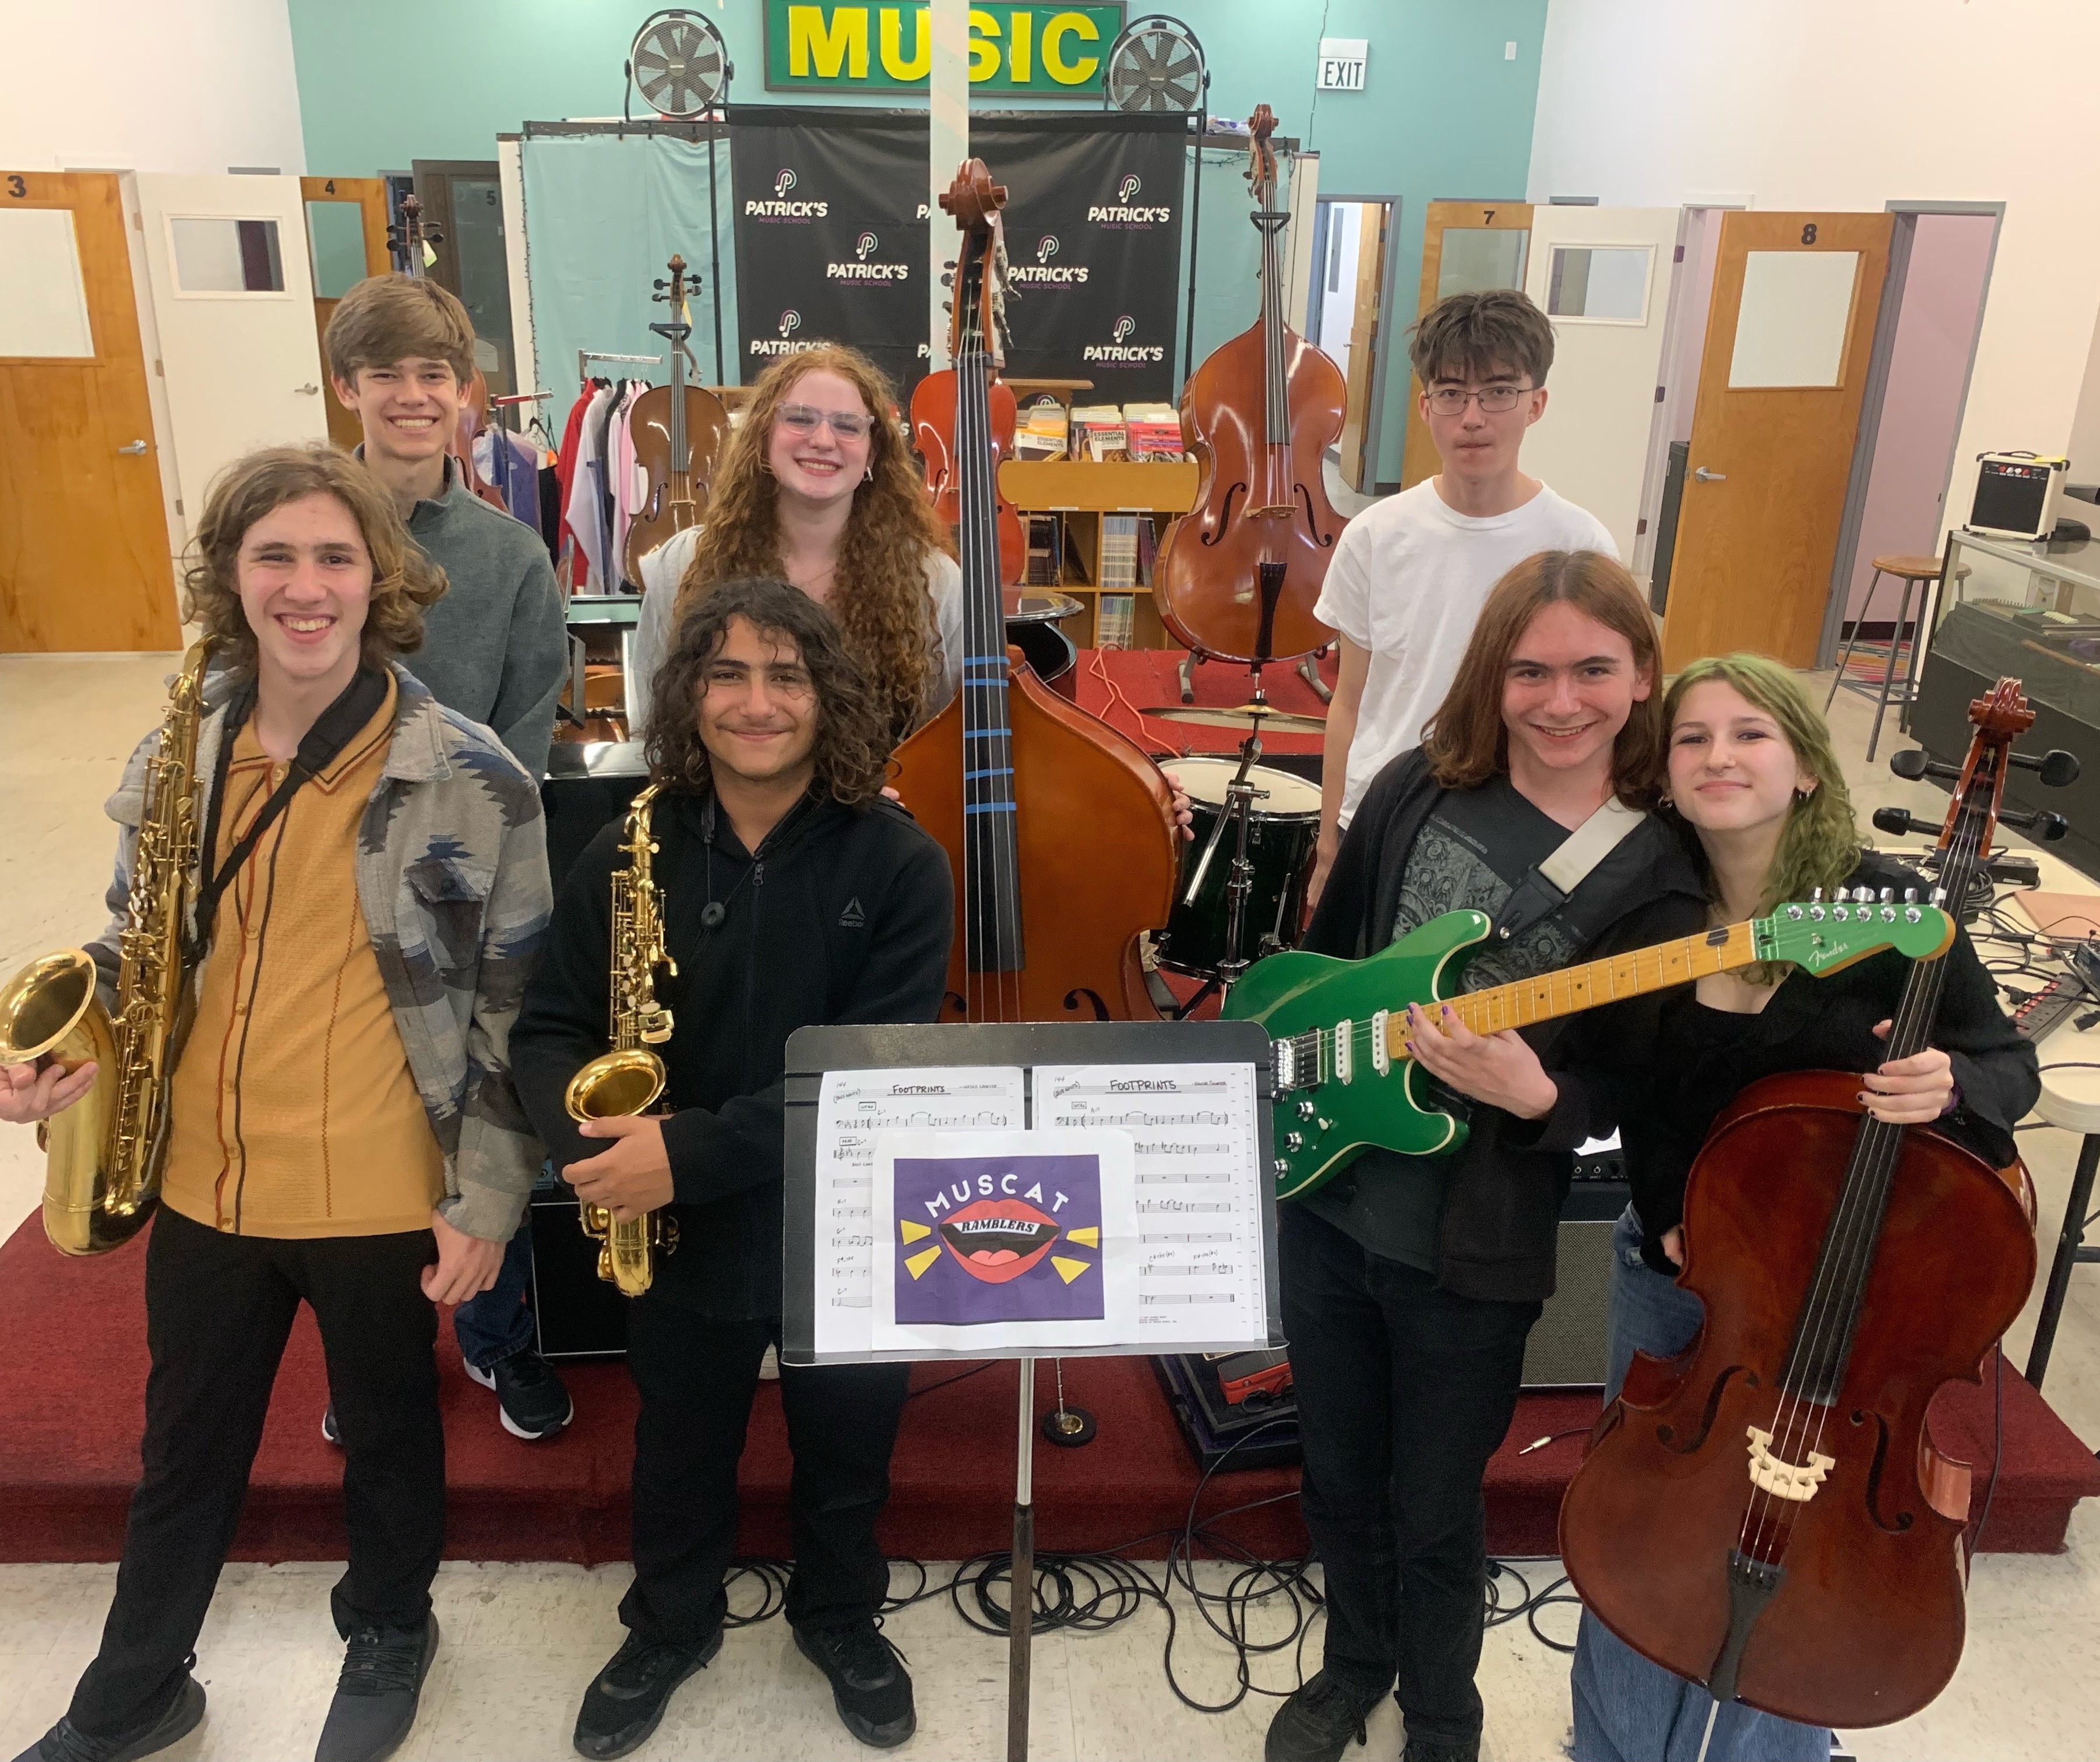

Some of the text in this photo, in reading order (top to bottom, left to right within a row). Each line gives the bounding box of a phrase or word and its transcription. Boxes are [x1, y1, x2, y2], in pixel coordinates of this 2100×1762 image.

[788, 5, 1100, 86] MUSIC
[1324, 61, 1362, 87] EXIT
[7, 175, 27, 198] 3
[325, 179, 336, 195] 4
[487, 190, 497, 206] 5
[745, 200, 828, 217] PATRICK'S
[1087, 207, 1171, 223] PATRICK'S
[1484, 210, 1495, 225] 7
[1801, 223, 1817, 245] 8
[827, 263, 908, 280] PATRICK'S
[1007, 267, 1089, 283] PATRICK'S
[1083, 346, 1164, 361] PATRICK'S
[838, 919, 864, 928] Reebo
[1808, 940, 1848, 967] Fender
[892, 1084, 946, 1094] FOOTPRINTS
[1110, 1080, 1176, 1091] FOOTPRINTS
[924, 1174, 1069, 1218] MUSCAT
[961, 1220, 1035, 1233] RAMBLERS
